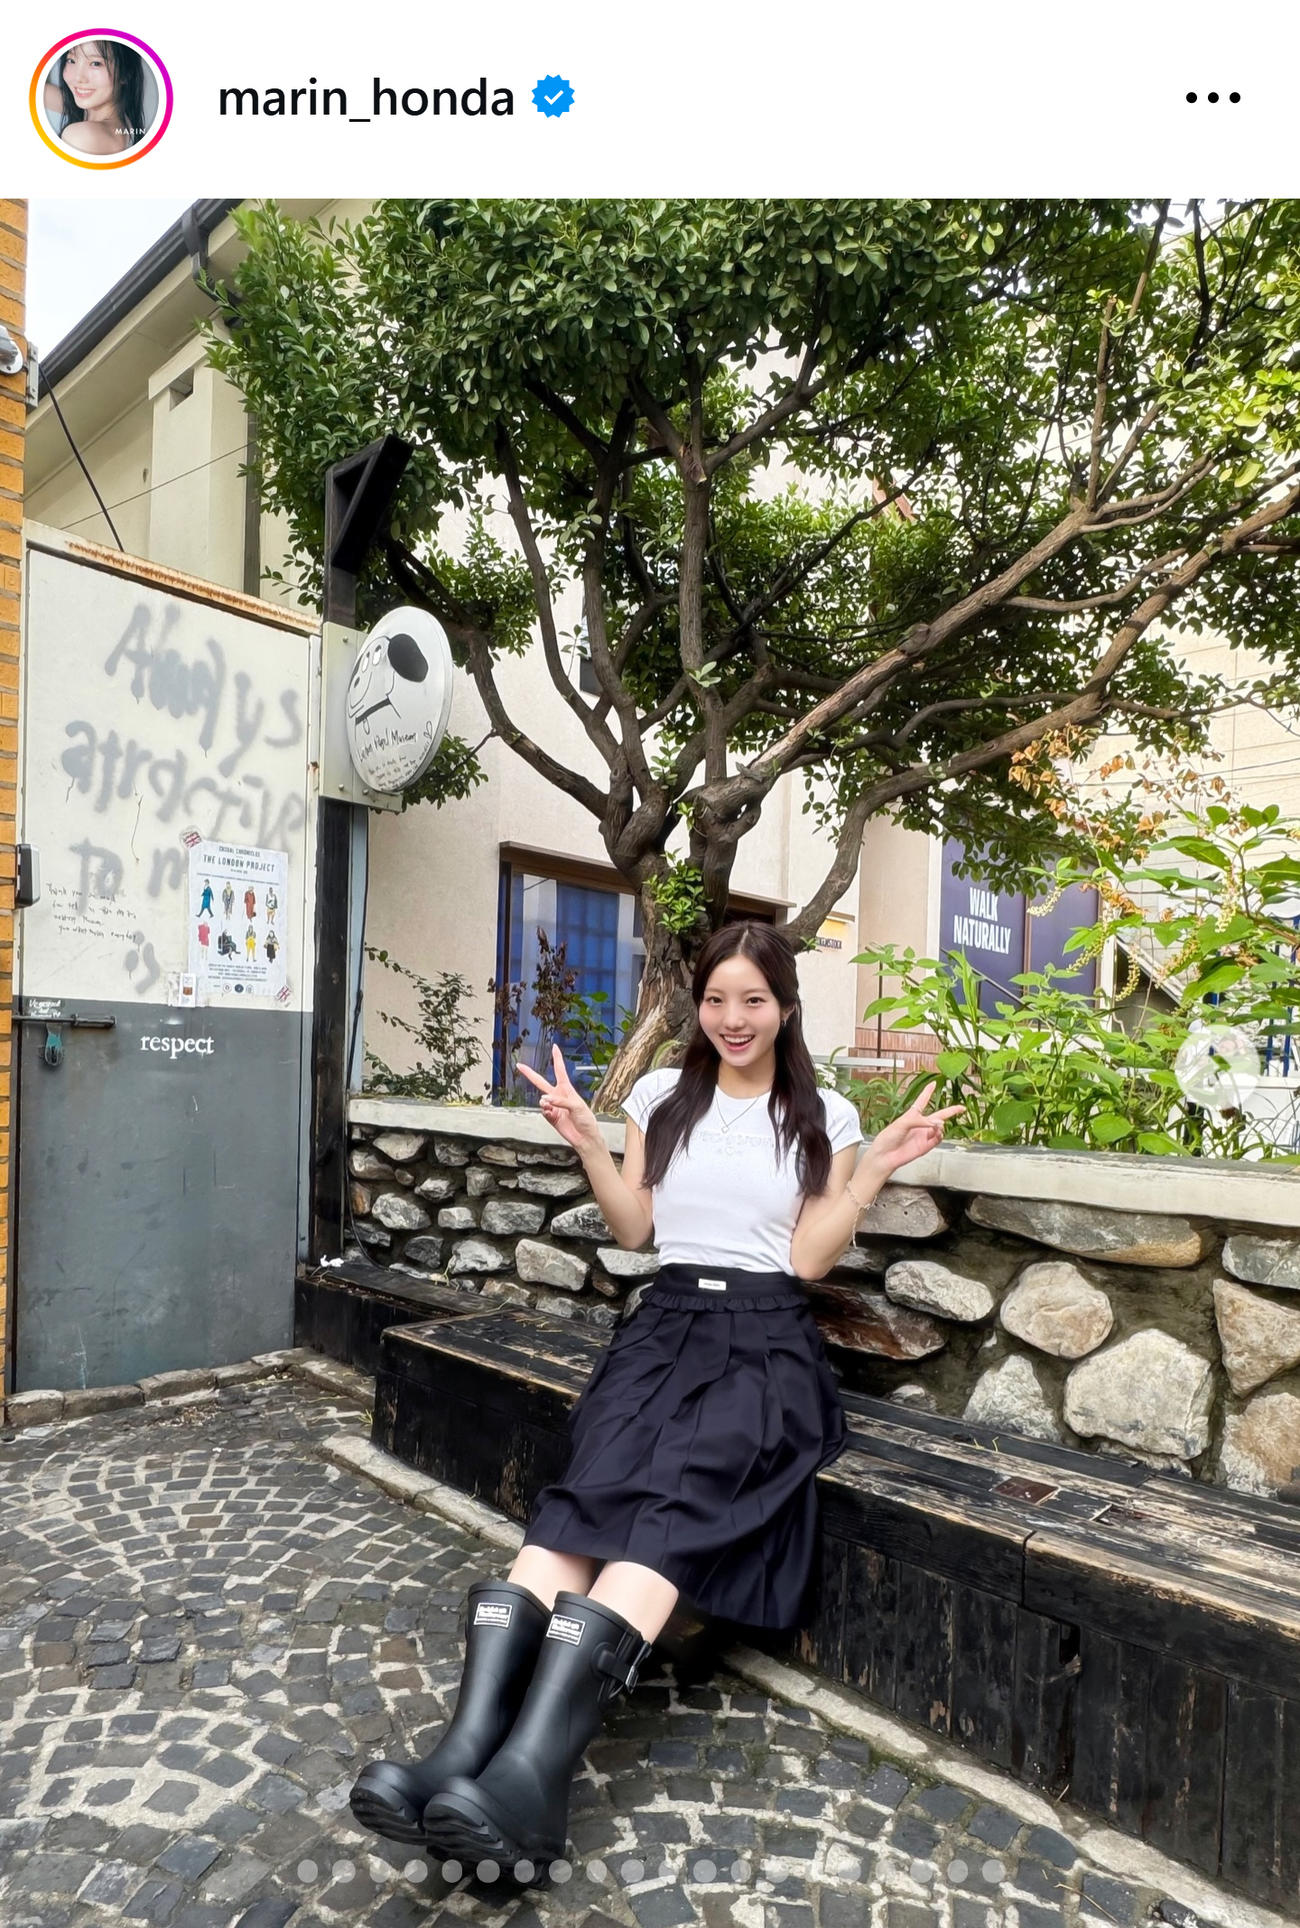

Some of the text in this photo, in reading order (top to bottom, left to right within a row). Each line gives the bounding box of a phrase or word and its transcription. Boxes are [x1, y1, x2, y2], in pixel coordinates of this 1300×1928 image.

[203, 854, 216, 865] THE
[218, 857, 244, 868] LONDON
[246, 861, 275, 873] PROJECT
[969, 886, 999, 922] WALK
[953, 914, 1012, 955] NATURALLY
[139, 1035, 215, 1060] respect
